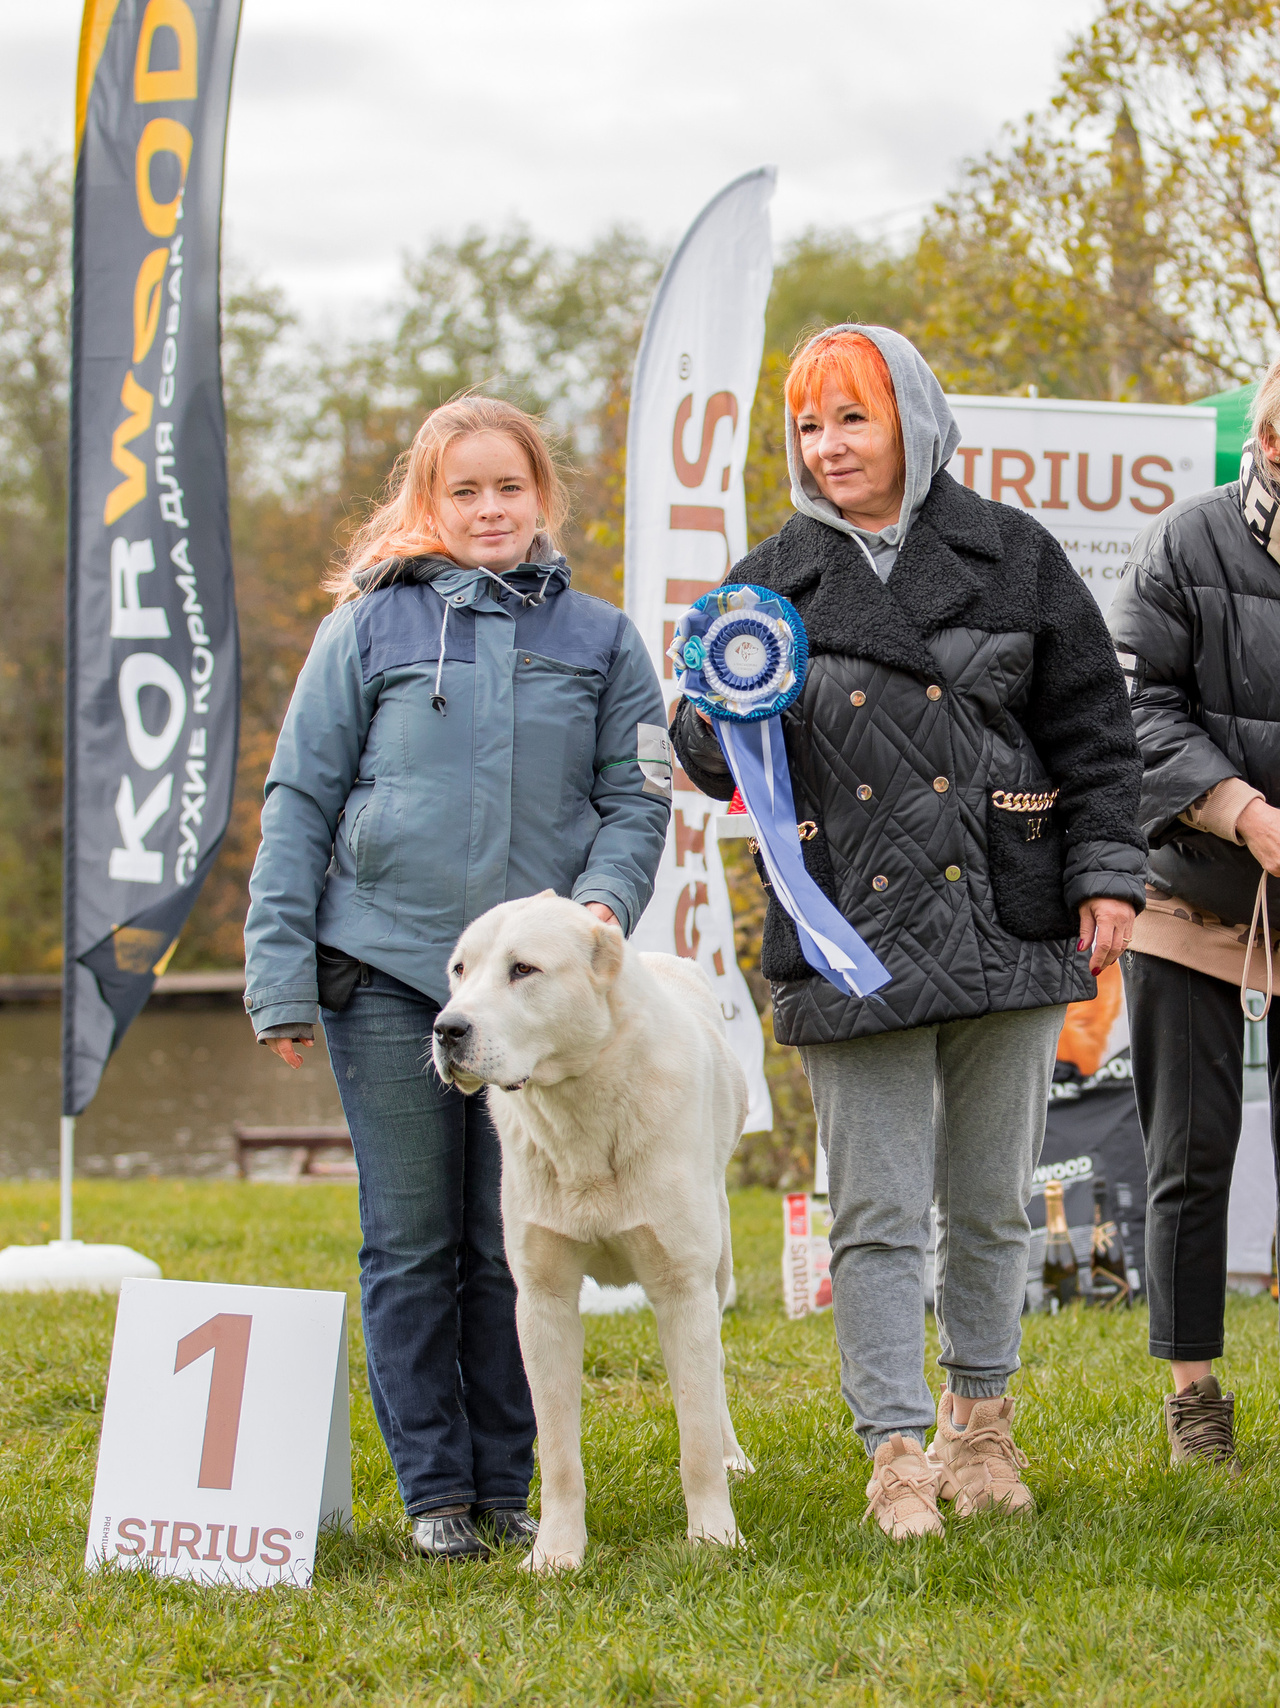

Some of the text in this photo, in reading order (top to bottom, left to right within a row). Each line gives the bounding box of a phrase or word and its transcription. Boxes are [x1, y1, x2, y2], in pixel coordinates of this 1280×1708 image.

[956, 447, 1175, 515] IRIUS
[155, 234, 214, 886] СУХИЕ КОРМА ДЛЯ СОБАК
[1032, 1155, 1093, 1183] WOOD
[791, 1243, 811, 1315] SIRIUS
[173, 1312, 253, 1491] 1
[115, 1517, 292, 1567] SIRIUS
